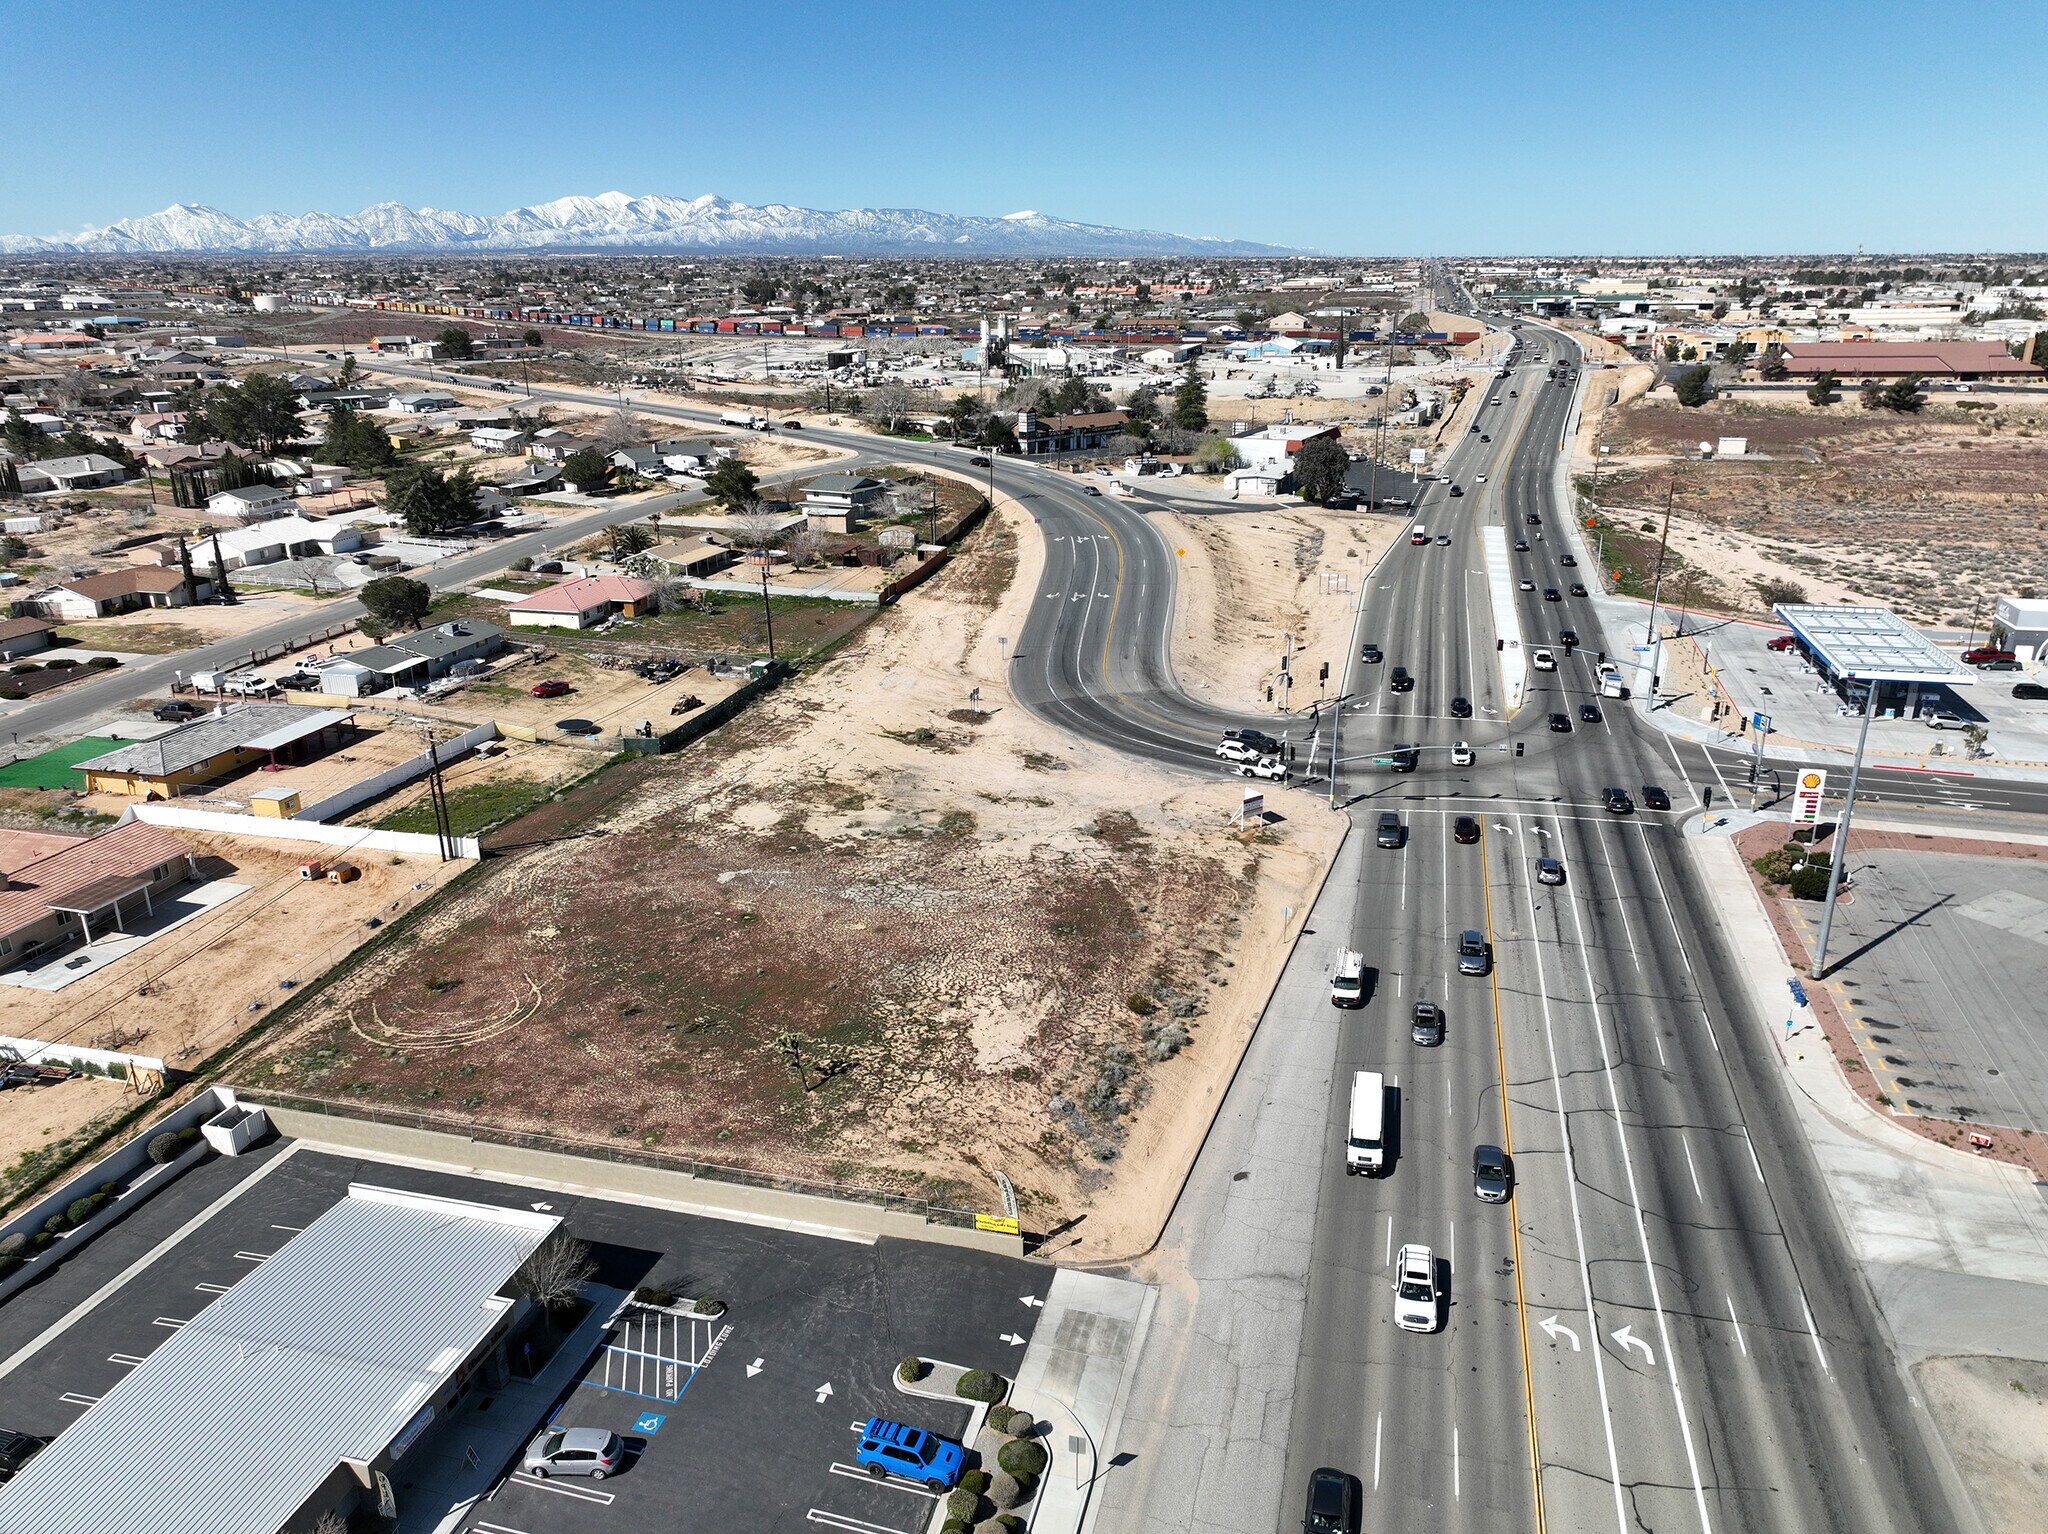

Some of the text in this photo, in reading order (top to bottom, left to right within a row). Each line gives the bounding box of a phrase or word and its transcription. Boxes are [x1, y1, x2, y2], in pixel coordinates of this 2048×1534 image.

[701, 1325, 735, 1368] LOADING ZONE
[666, 1365, 674, 1398] NO PARKING
